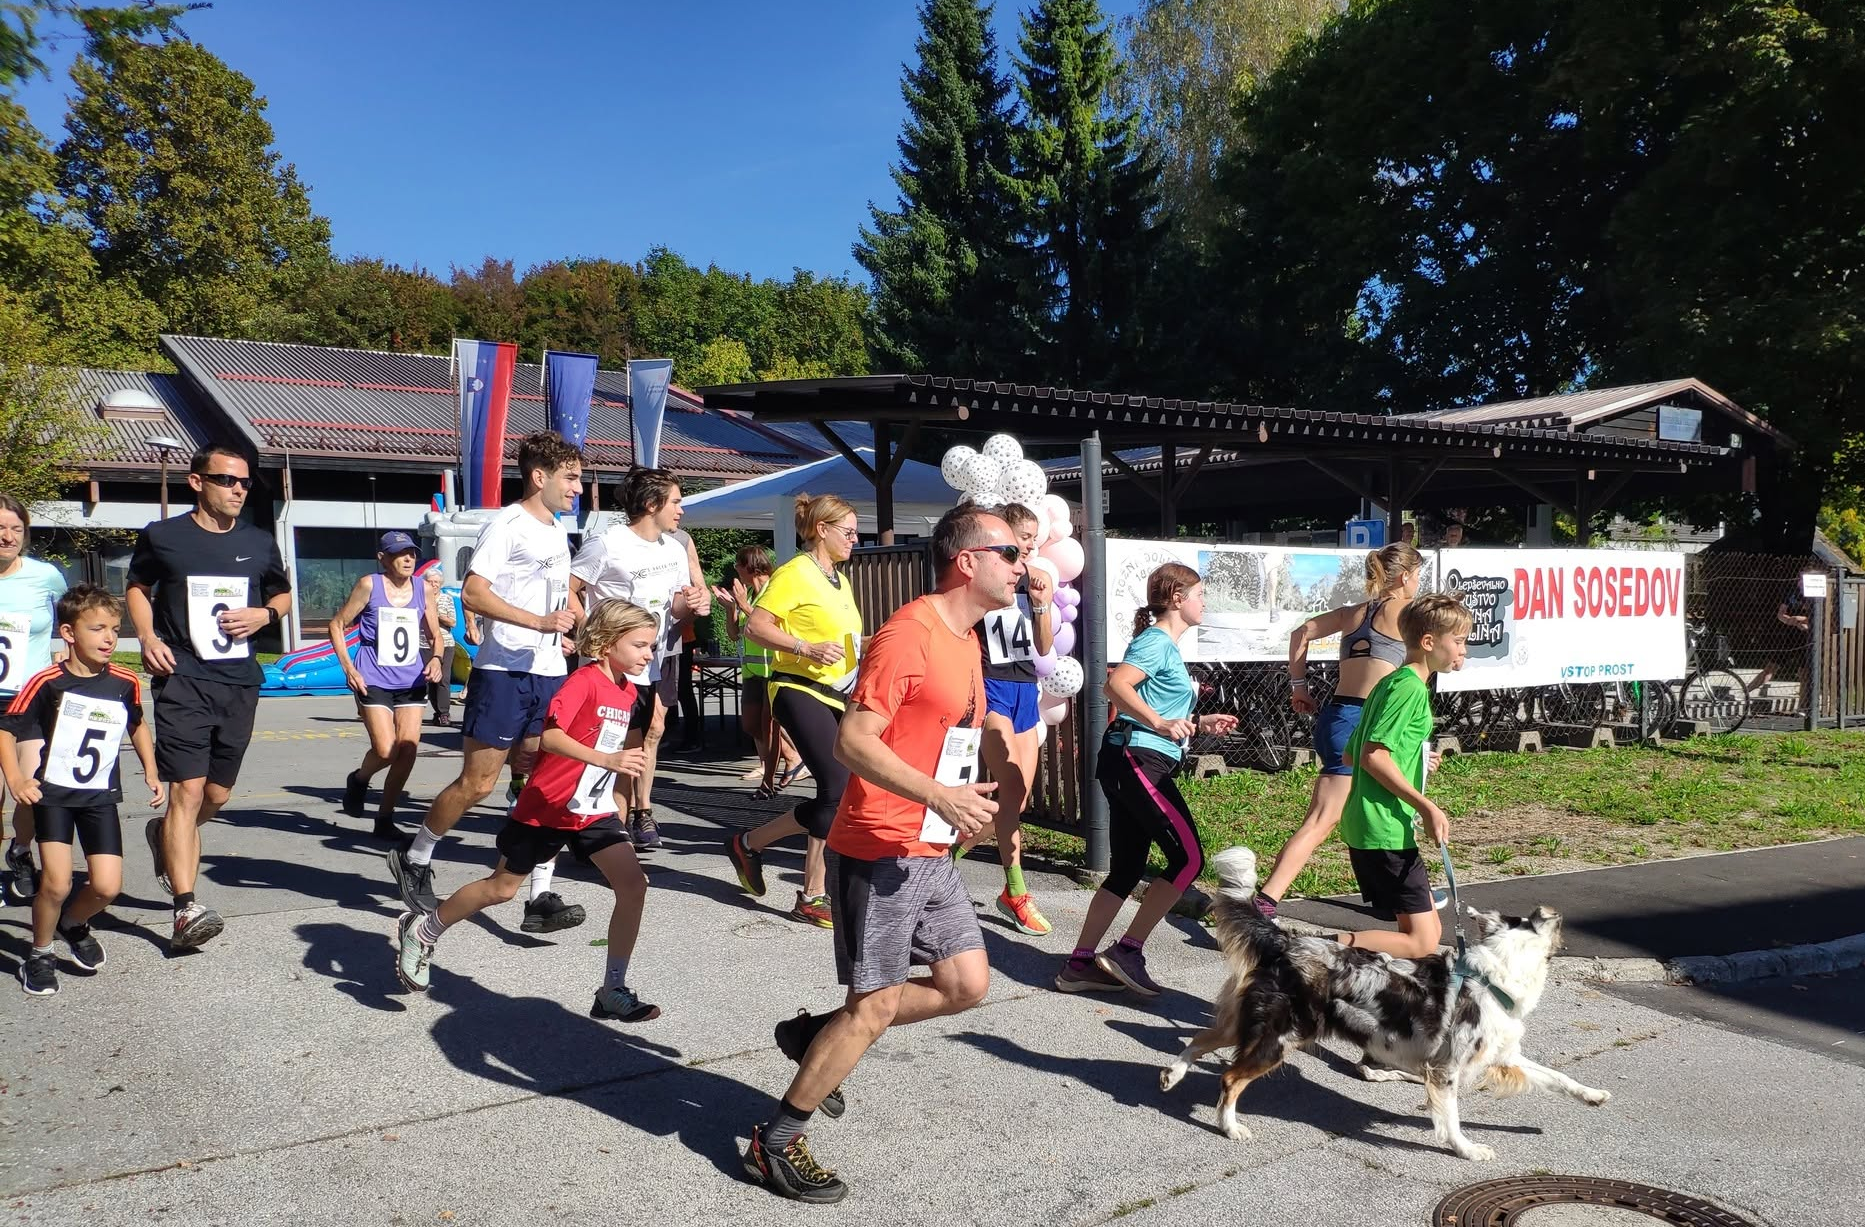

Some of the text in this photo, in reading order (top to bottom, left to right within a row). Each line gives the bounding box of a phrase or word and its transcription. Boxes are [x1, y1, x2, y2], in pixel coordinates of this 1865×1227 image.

[1460, 592, 1496, 608] UŠTVO
[1513, 566, 1682, 620] DAN SOSEDOV
[211, 602, 233, 654] 3
[393, 626, 409, 663] 9
[991, 613, 1032, 659] 14
[1467, 623, 1502, 643] LINA
[1561, 663, 1635, 678] VSTOP PROST
[72, 727, 107, 784] 5
[588, 769, 614, 809] 4
